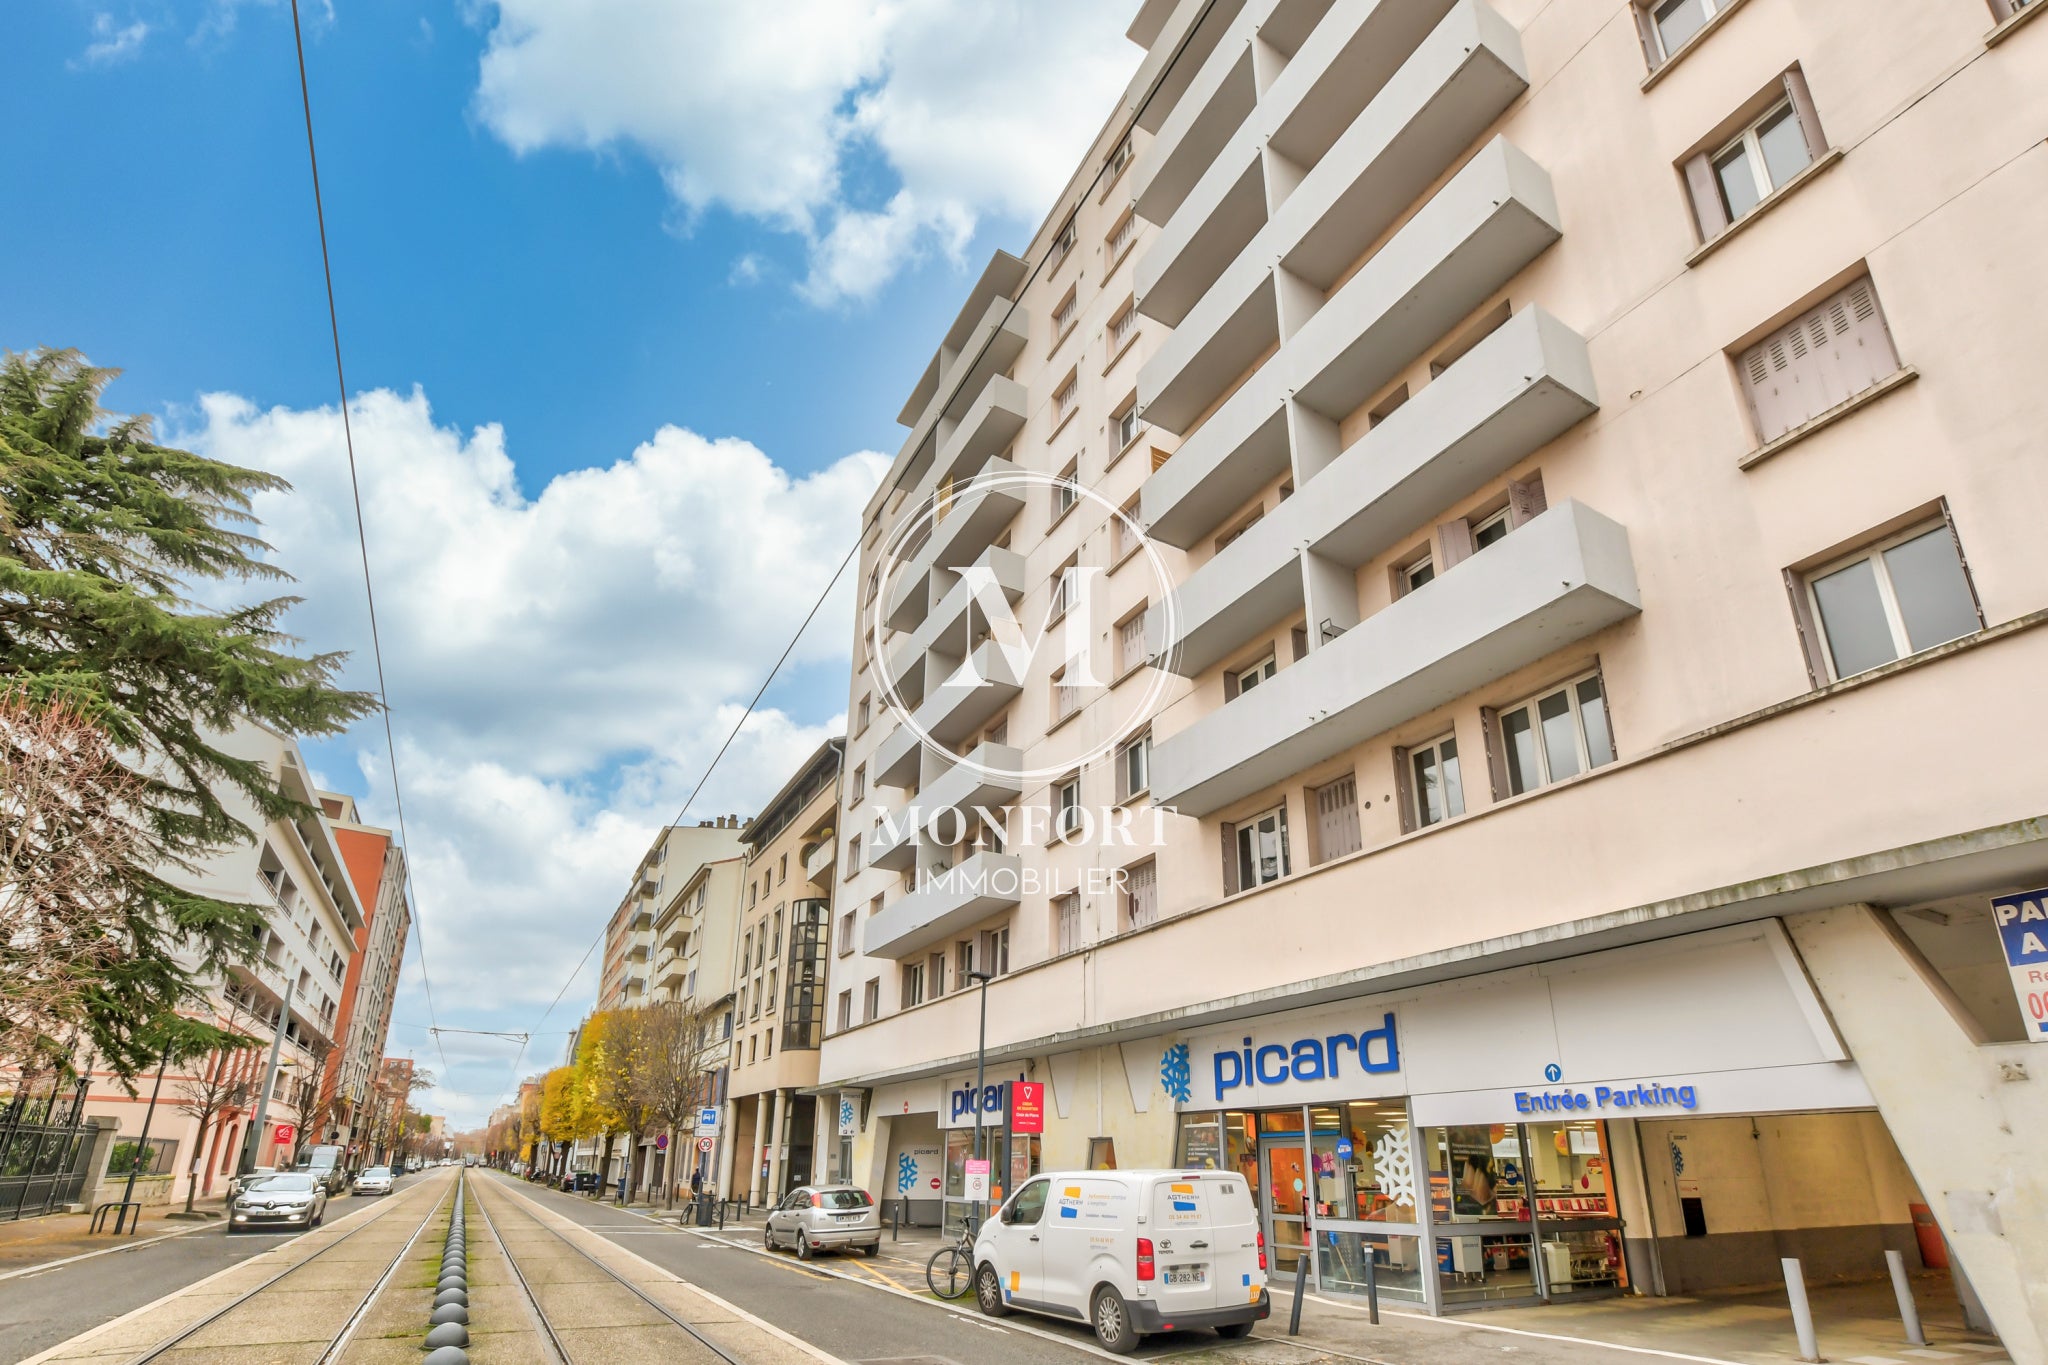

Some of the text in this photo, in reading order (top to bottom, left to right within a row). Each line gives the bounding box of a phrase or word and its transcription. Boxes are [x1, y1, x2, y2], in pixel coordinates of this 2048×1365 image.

[1213, 1012, 1400, 1101] picard
[952, 1072, 1025, 1123] picar
[1515, 1082, 1697, 1114] Entrée Parking
